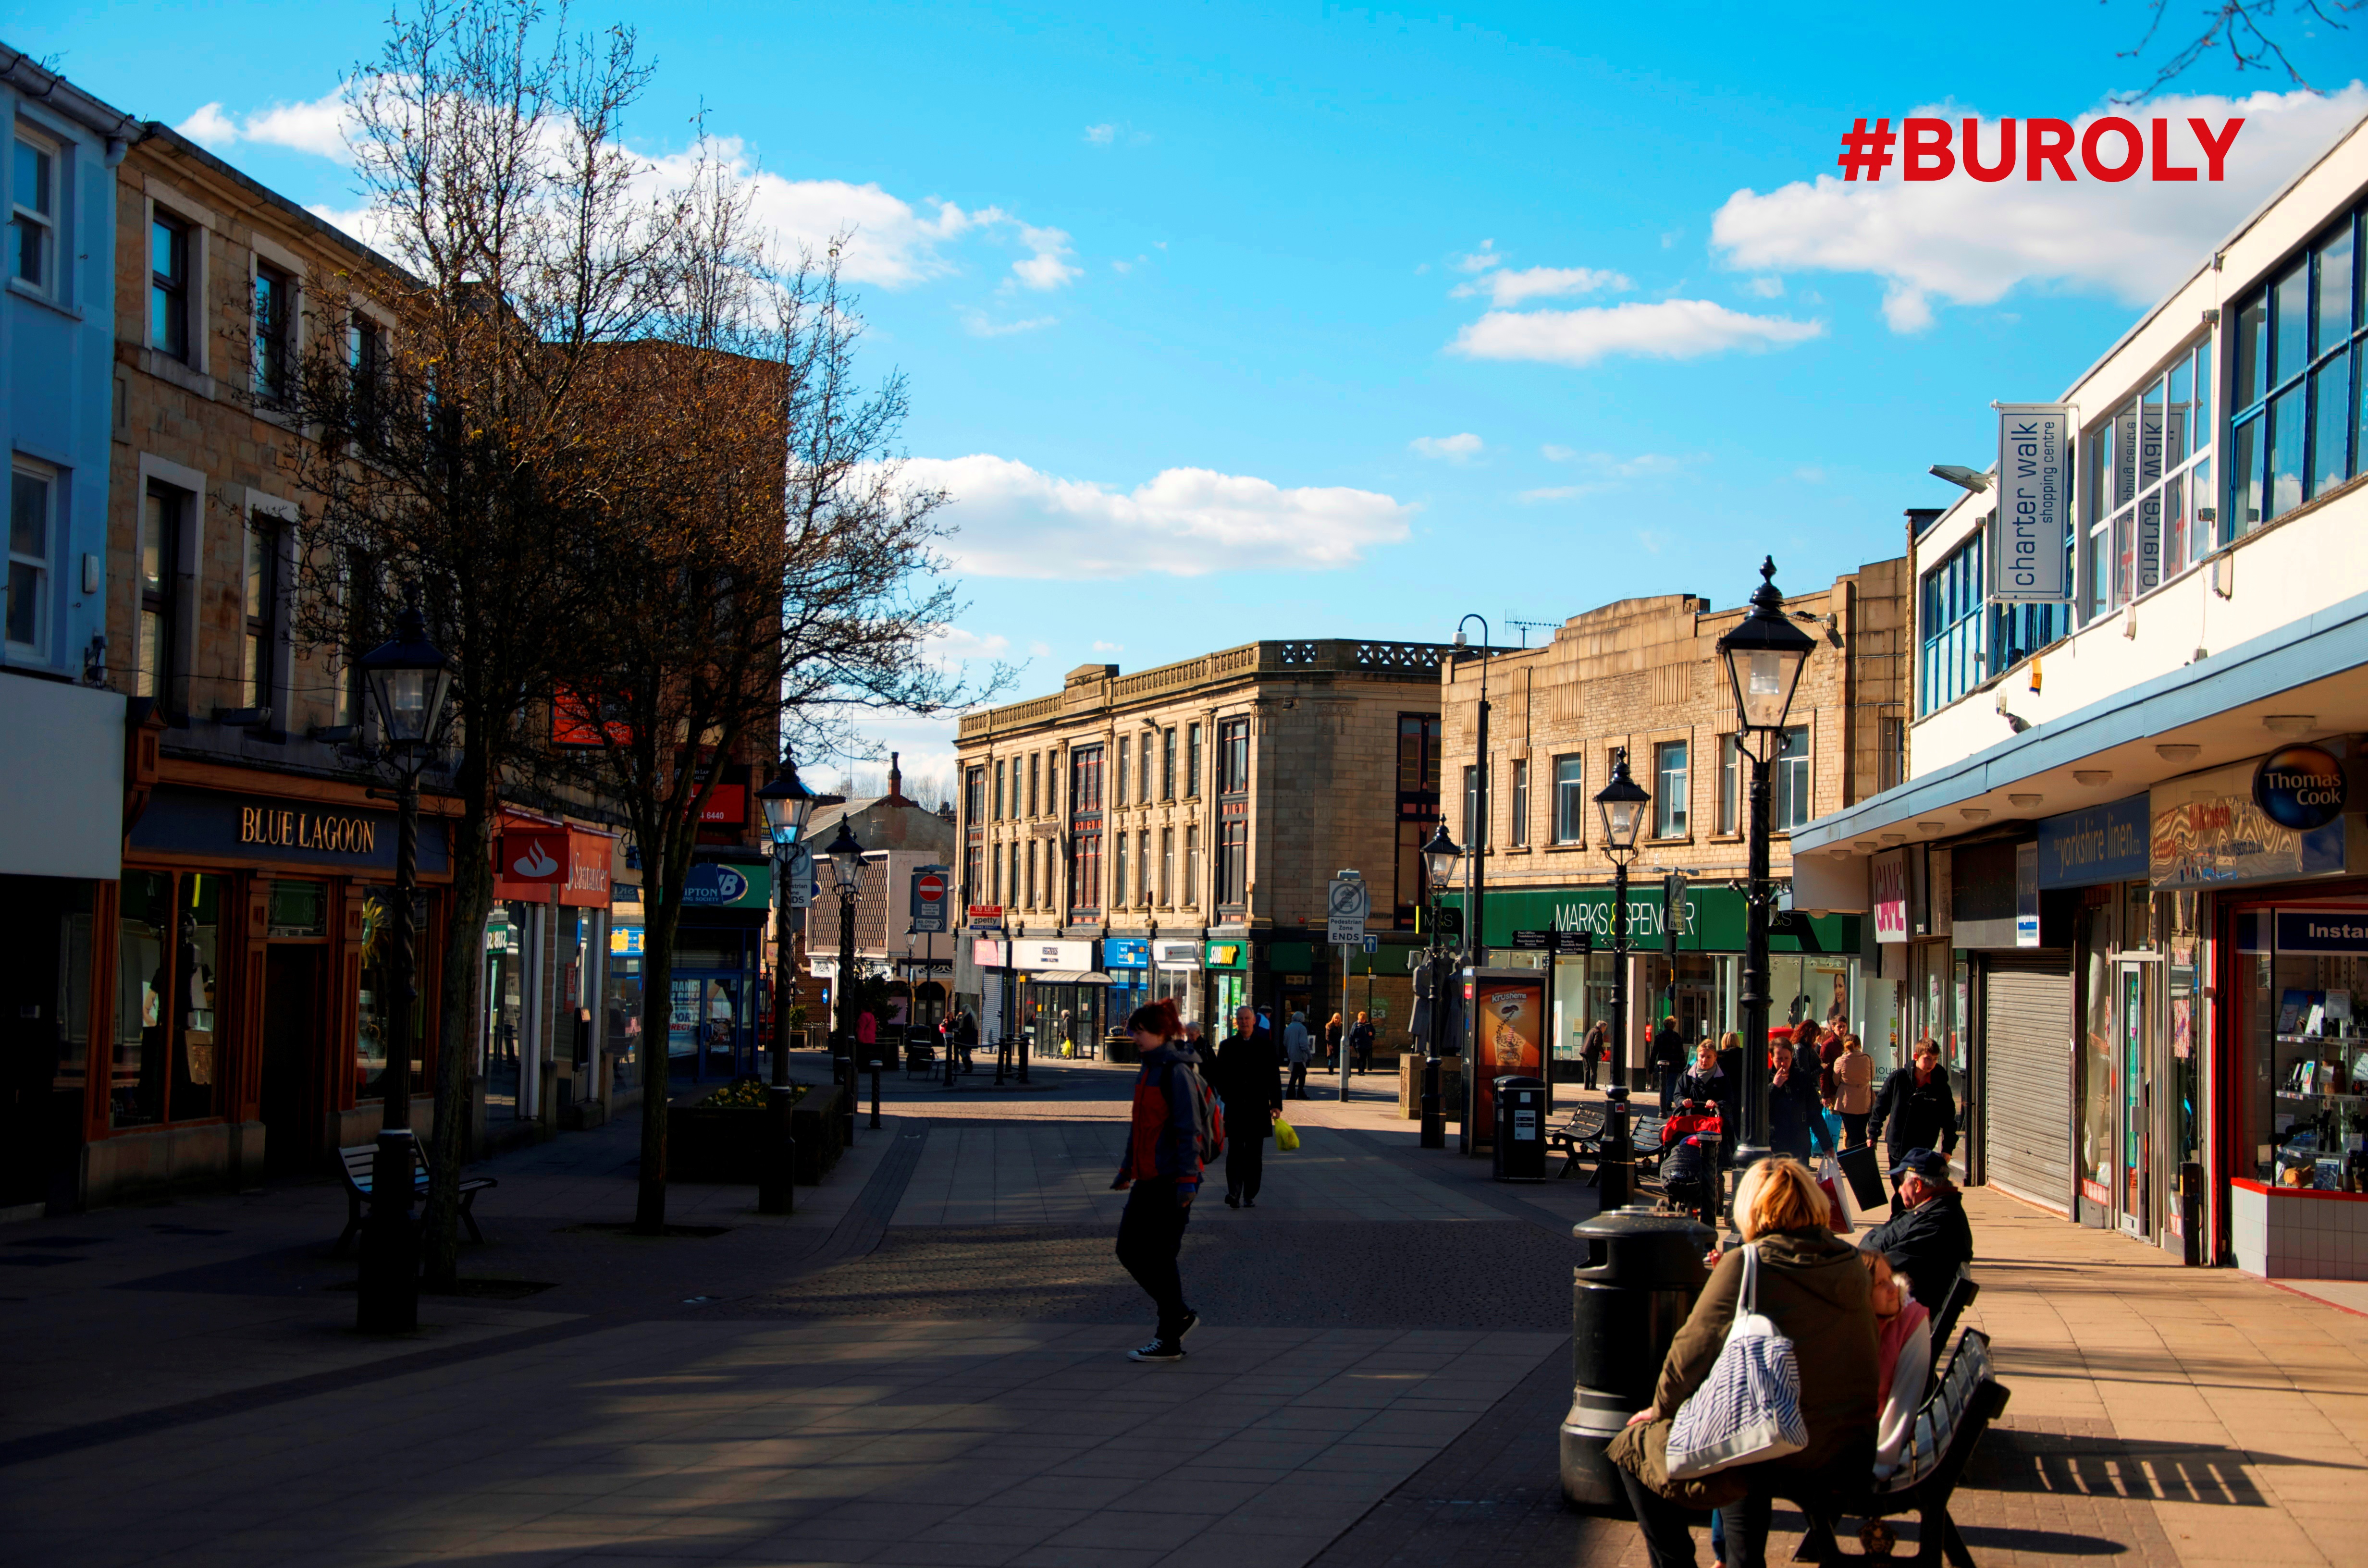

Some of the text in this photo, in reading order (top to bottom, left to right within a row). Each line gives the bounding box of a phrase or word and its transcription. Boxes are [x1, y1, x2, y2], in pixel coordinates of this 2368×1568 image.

[2039, 422, 2057, 523] shopping centre
[2008, 422, 2037, 586] charter walk
[2264, 772, 2341, 789] Thomas
[2296, 788, 2341, 805] Cook
[240, 807, 375, 853] BLUE LAGOON
[706, 811, 724, 820] 6440
[2189, 803, 2231, 831] Wilkinson
[2060, 818, 2104, 878] yorkshire
[2108, 812, 2132, 858] linen
[2133, 839, 2141, 855] co.
[2153, 837, 2176, 858] Canon
[574, 852, 607, 892] Santander
[1876, 861, 1903, 932] GAME
[1555, 903, 1608, 935] MARKS
[1209, 946, 1236, 964] SUBWAY
